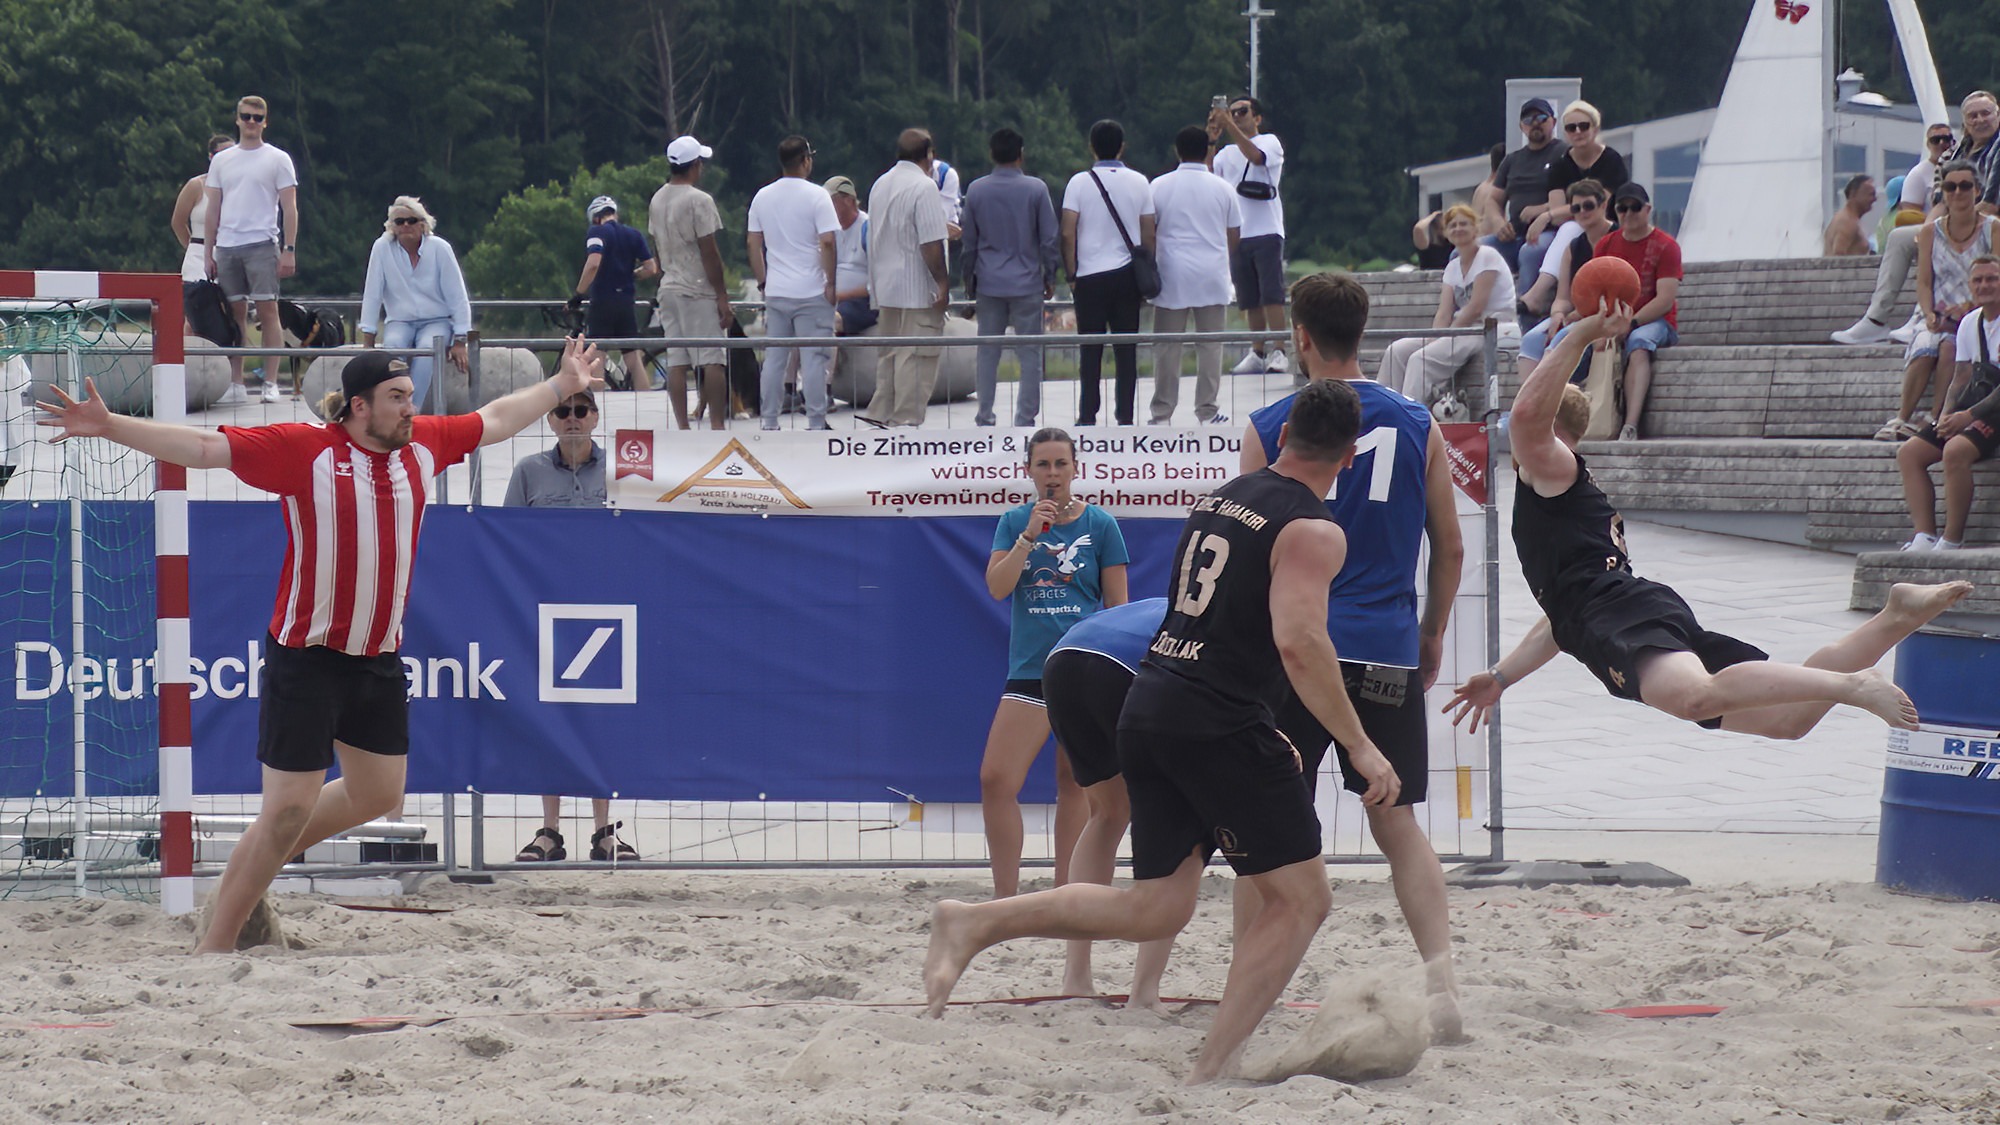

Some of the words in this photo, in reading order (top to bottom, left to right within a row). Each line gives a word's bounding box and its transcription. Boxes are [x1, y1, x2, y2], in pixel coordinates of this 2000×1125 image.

[828, 437, 867, 456] Die
[874, 435, 993, 456] Zimmerei
[1002, 436, 1016, 452] &
[1132, 434, 1200, 453] Kevin
[1209, 435, 1241, 453] Du
[1325, 426, 1398, 502] 1
[931, 462, 1027, 480] wünsch
[1095, 463, 1156, 484] Spaß
[1164, 463, 1227, 480] beim
[867, 488, 1032, 506] Travemünder
[1174, 530, 1230, 618] 13
[15, 639, 266, 700] Deutsch
[400, 641, 507, 700] ank
